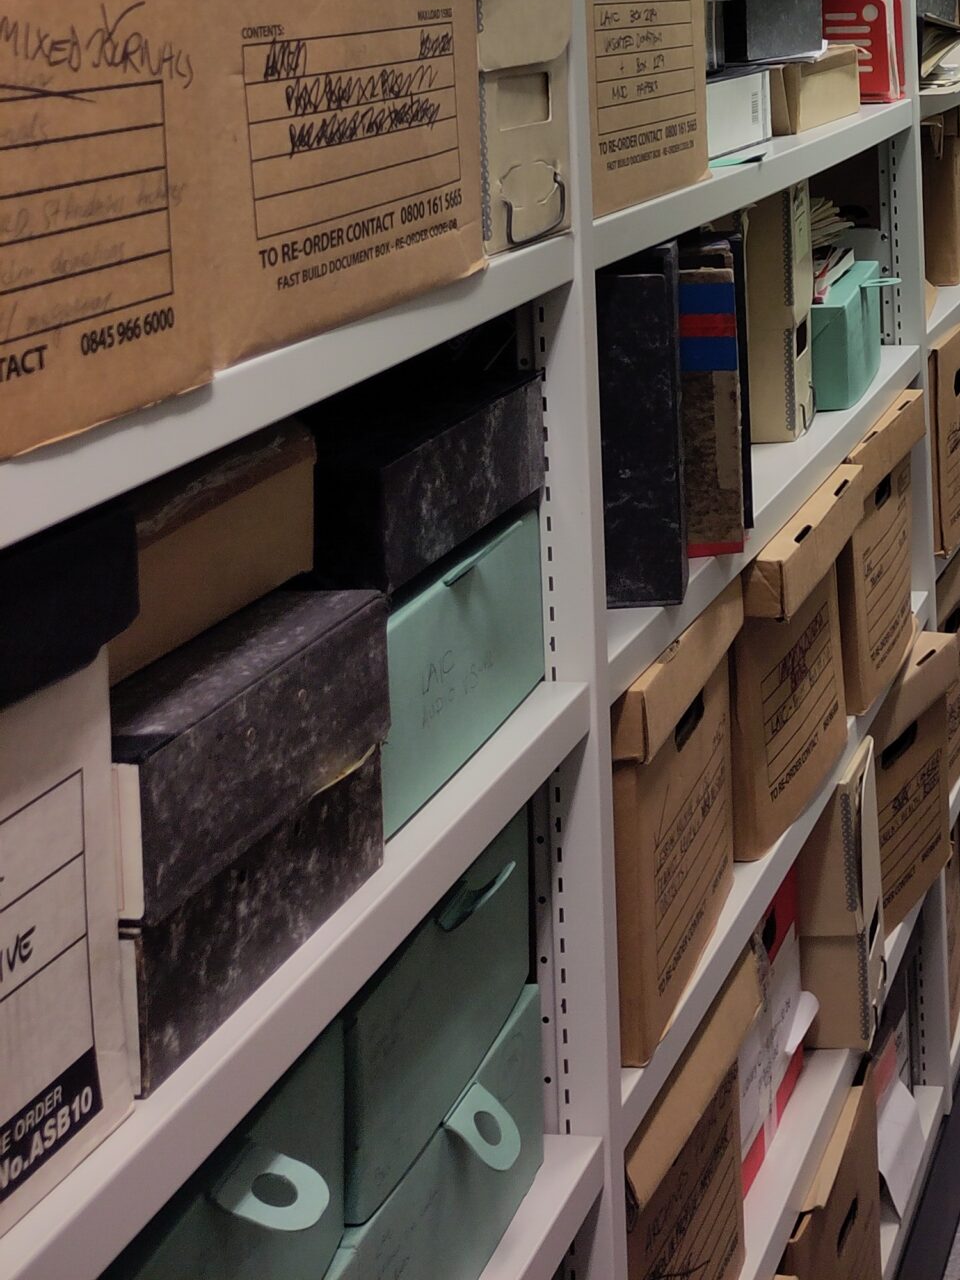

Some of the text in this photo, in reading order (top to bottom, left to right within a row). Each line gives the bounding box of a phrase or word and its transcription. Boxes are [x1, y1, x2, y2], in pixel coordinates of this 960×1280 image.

[241, 23, 285, 40] CONTENTS:
[599, 141, 609, 156] TO
[608, 133, 638, 154] RE-ORDER
[638, 128, 664, 147] CONTACT
[258, 187, 463, 270] TO RE-ORDER CONTACT 0800 161 5665
[276, 272, 301, 291] FAST
[301, 262, 329, 284] BUILD
[328, 247, 375, 275] DOCUMENT
[374, 242, 392, 258] BOX
[80, 326, 116, 357] 0845
[116, 315, 143, 345] 966
[142, 306, 176, 337] 6000
[14, 1085, 63, 1142] ORDER
